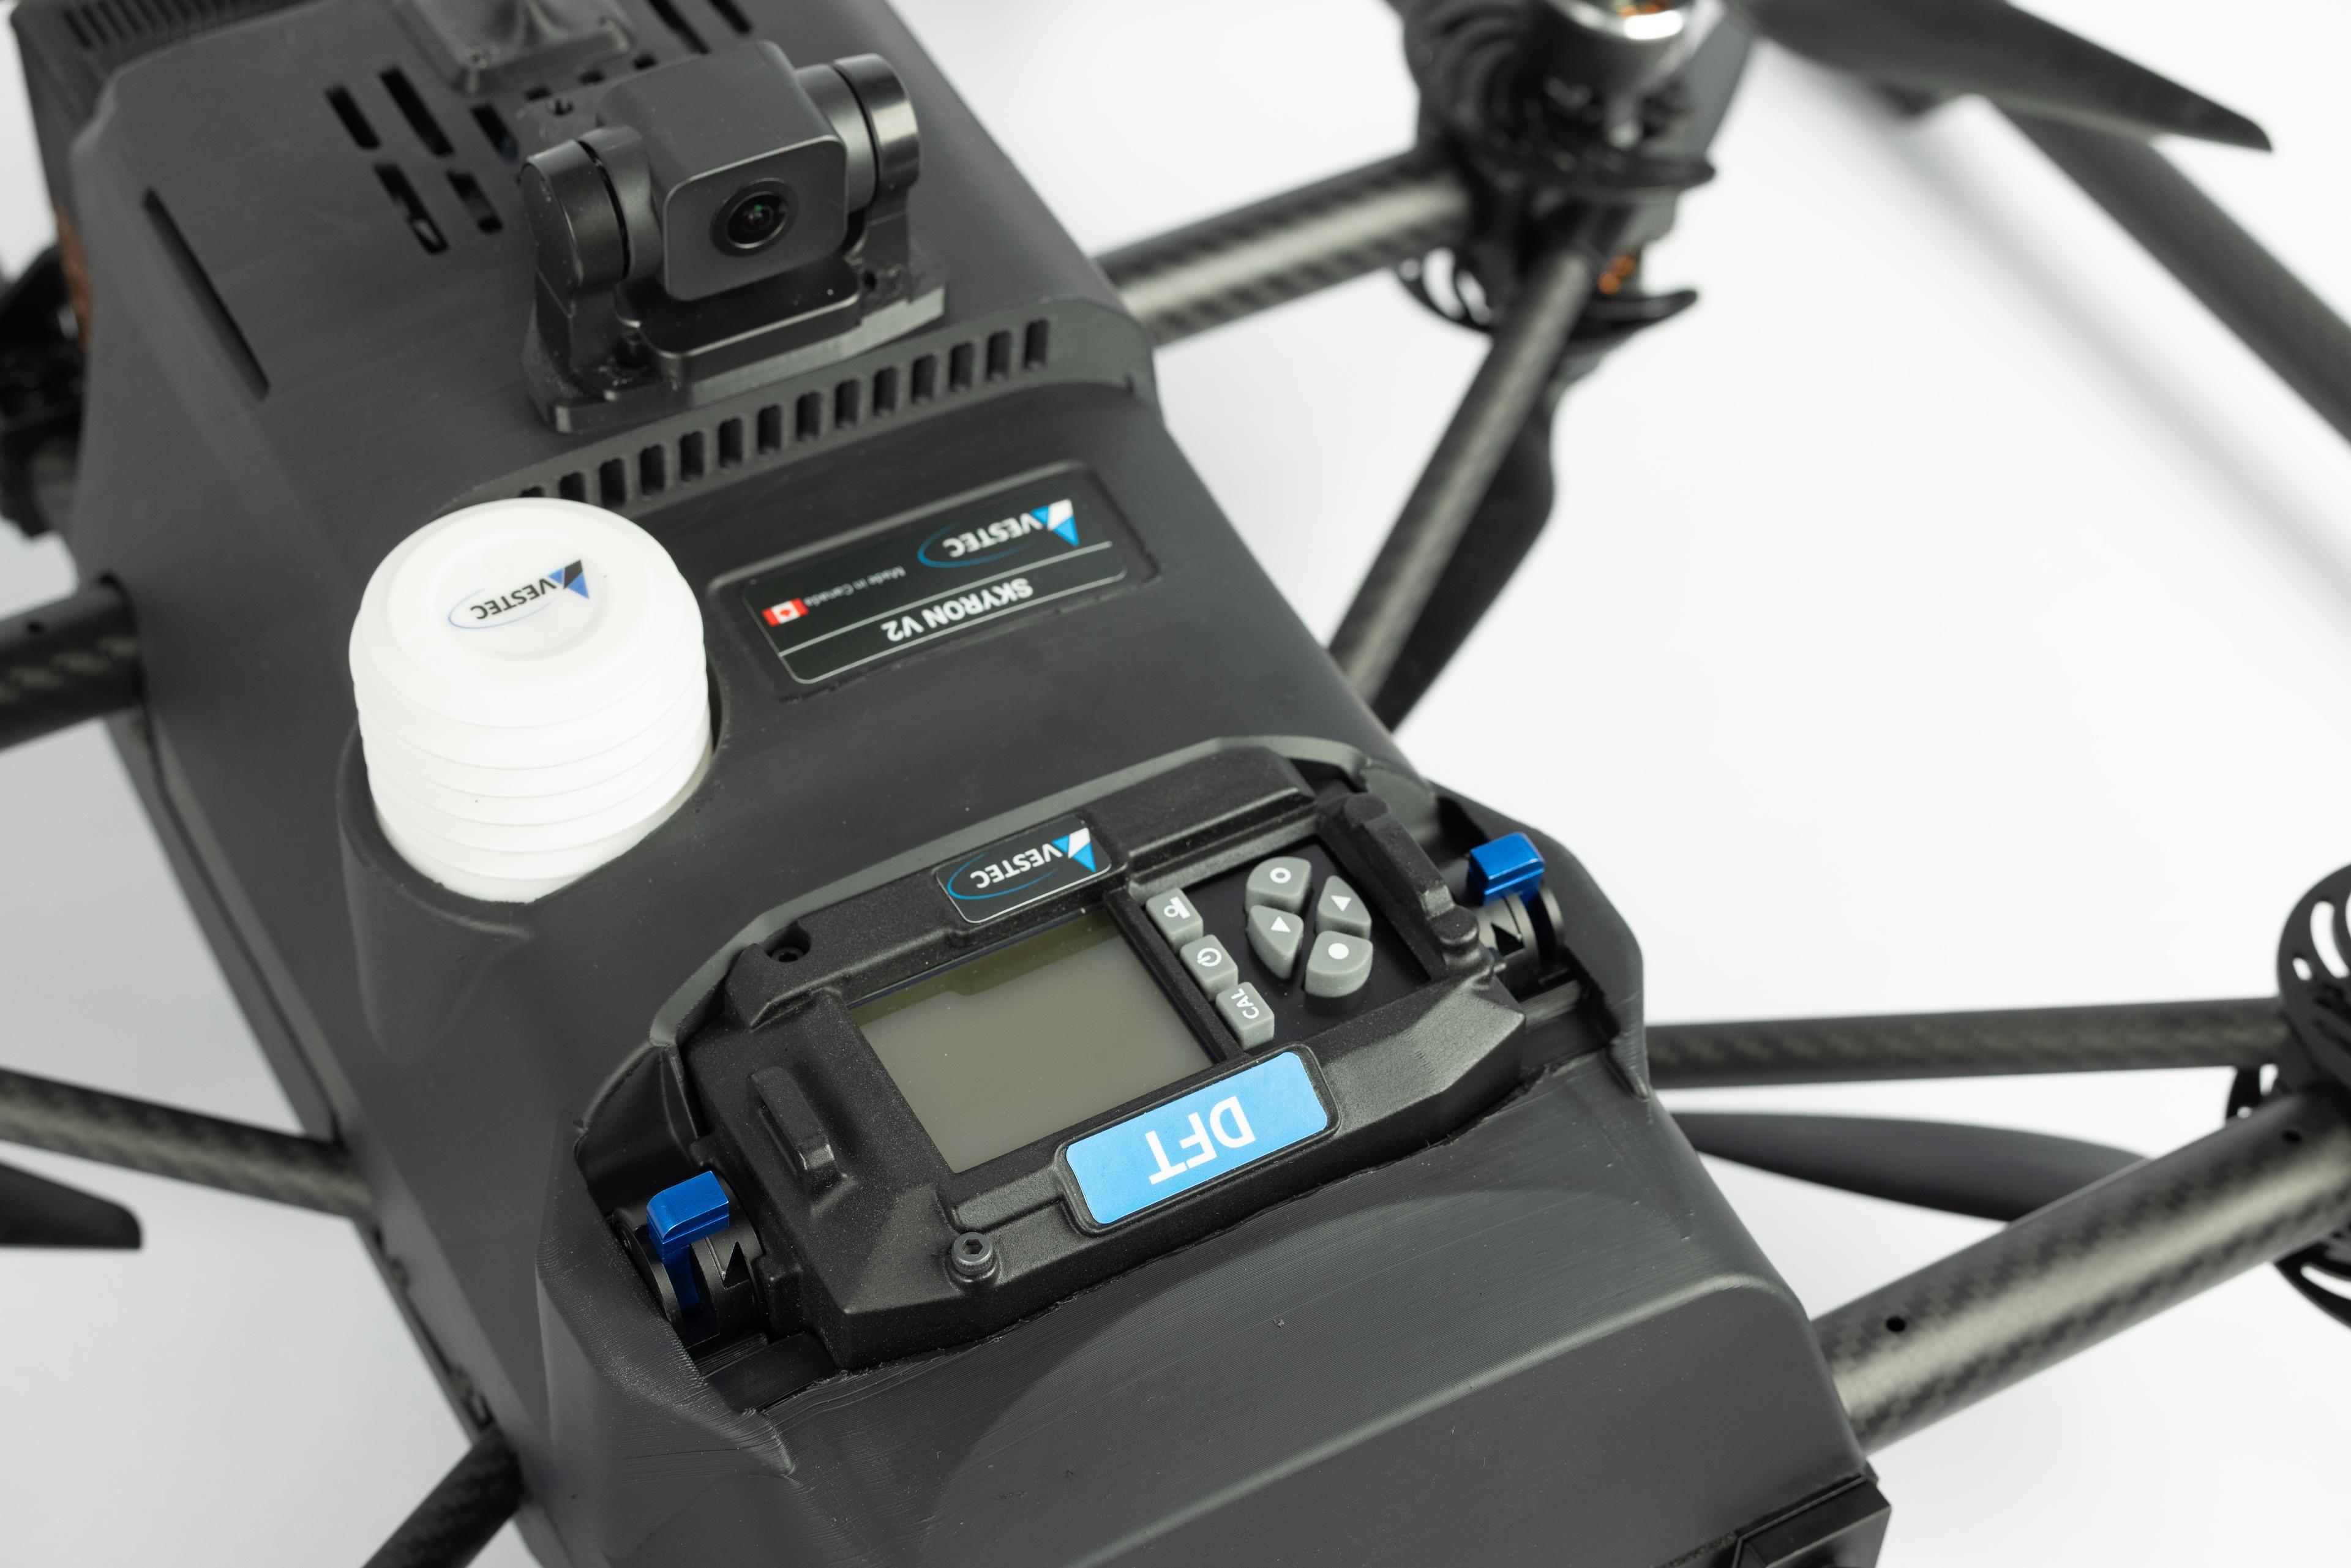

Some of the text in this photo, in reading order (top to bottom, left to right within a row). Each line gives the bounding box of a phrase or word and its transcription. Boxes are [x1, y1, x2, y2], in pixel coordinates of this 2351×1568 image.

[942, 512, 1043, 558] VESTEC
[470, 578, 557, 620] VESTEC
[803, 565, 907, 607] Made in Canada
[880, 577, 1033, 642] SKYRON V2
[969, 842, 1063, 889] VESTEC
[1231, 988, 1259, 1019] CAL
[1144, 1095, 1256, 1185] DFT
